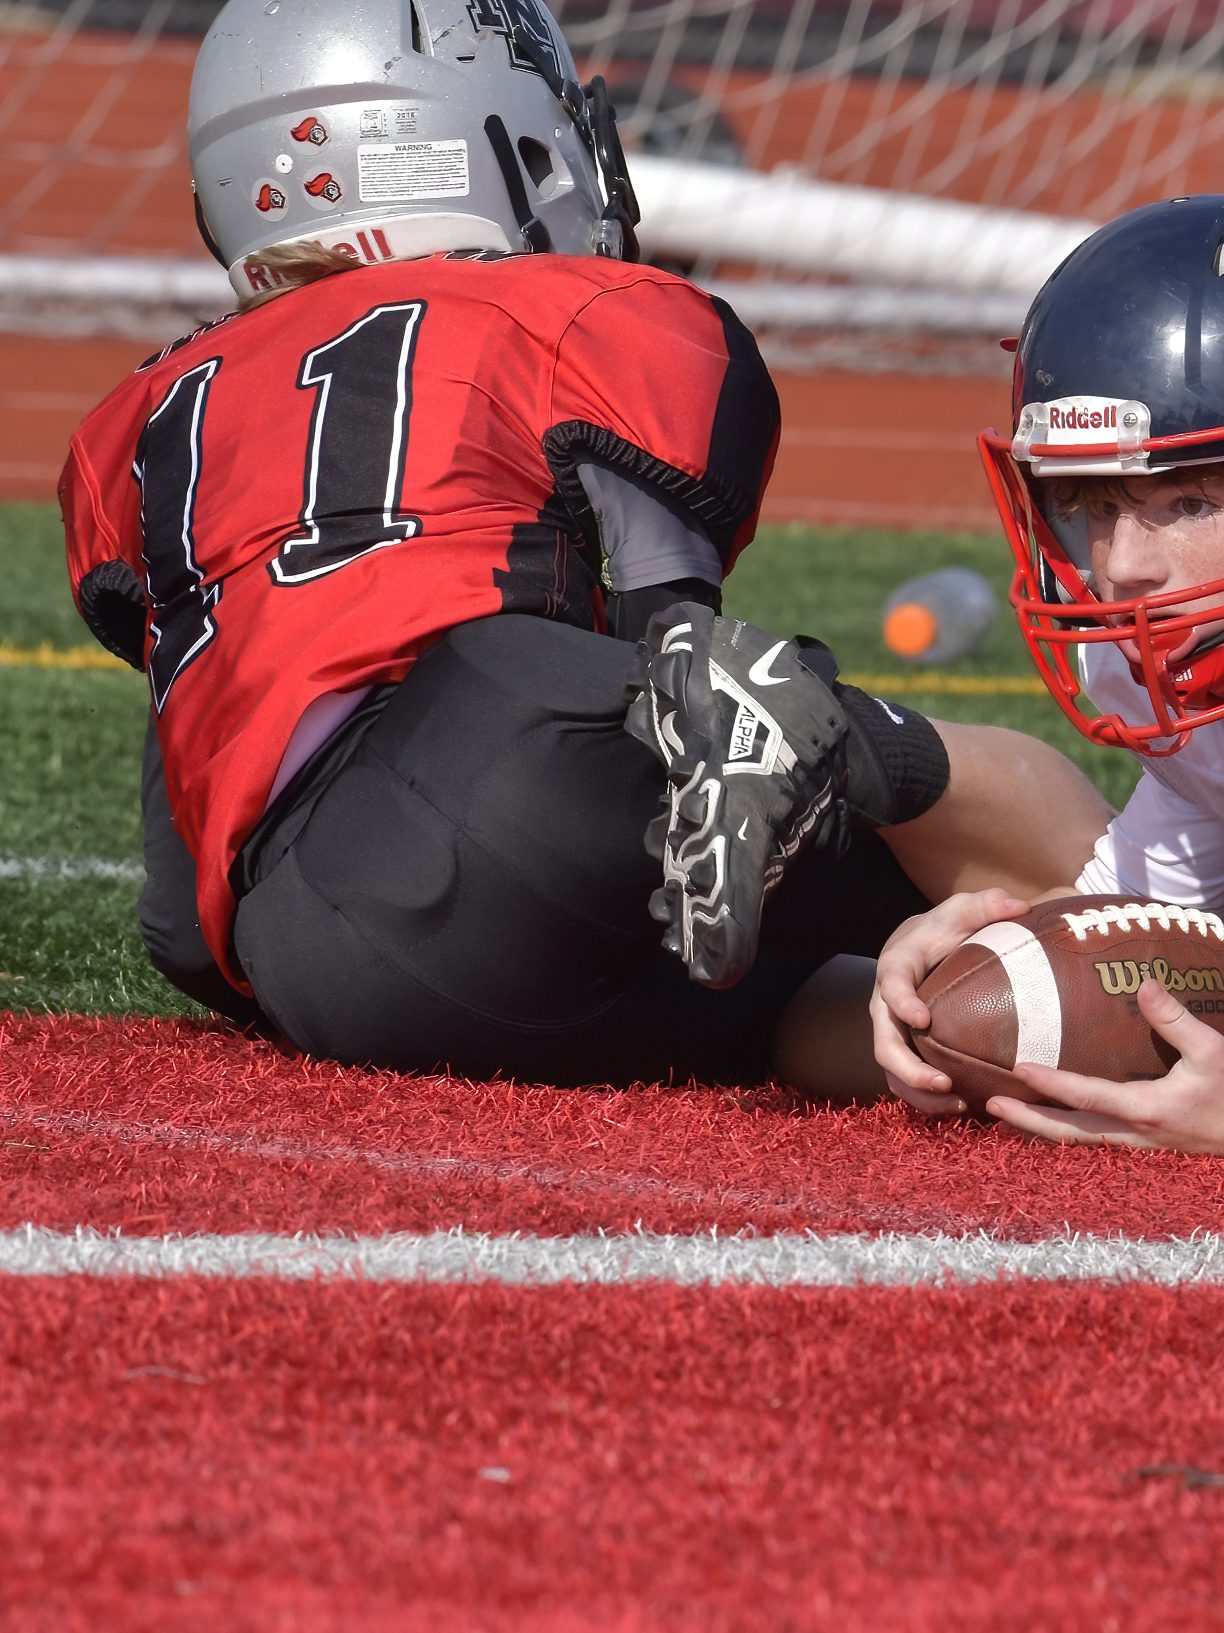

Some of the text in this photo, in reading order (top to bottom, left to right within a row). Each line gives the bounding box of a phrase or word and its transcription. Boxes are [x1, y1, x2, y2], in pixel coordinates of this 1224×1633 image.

[394, 143, 433, 152] WARNING
[243, 228, 395, 291] Riell
[1050, 405, 1117, 429] Riddell
[733, 704, 756, 757] ALPHA
